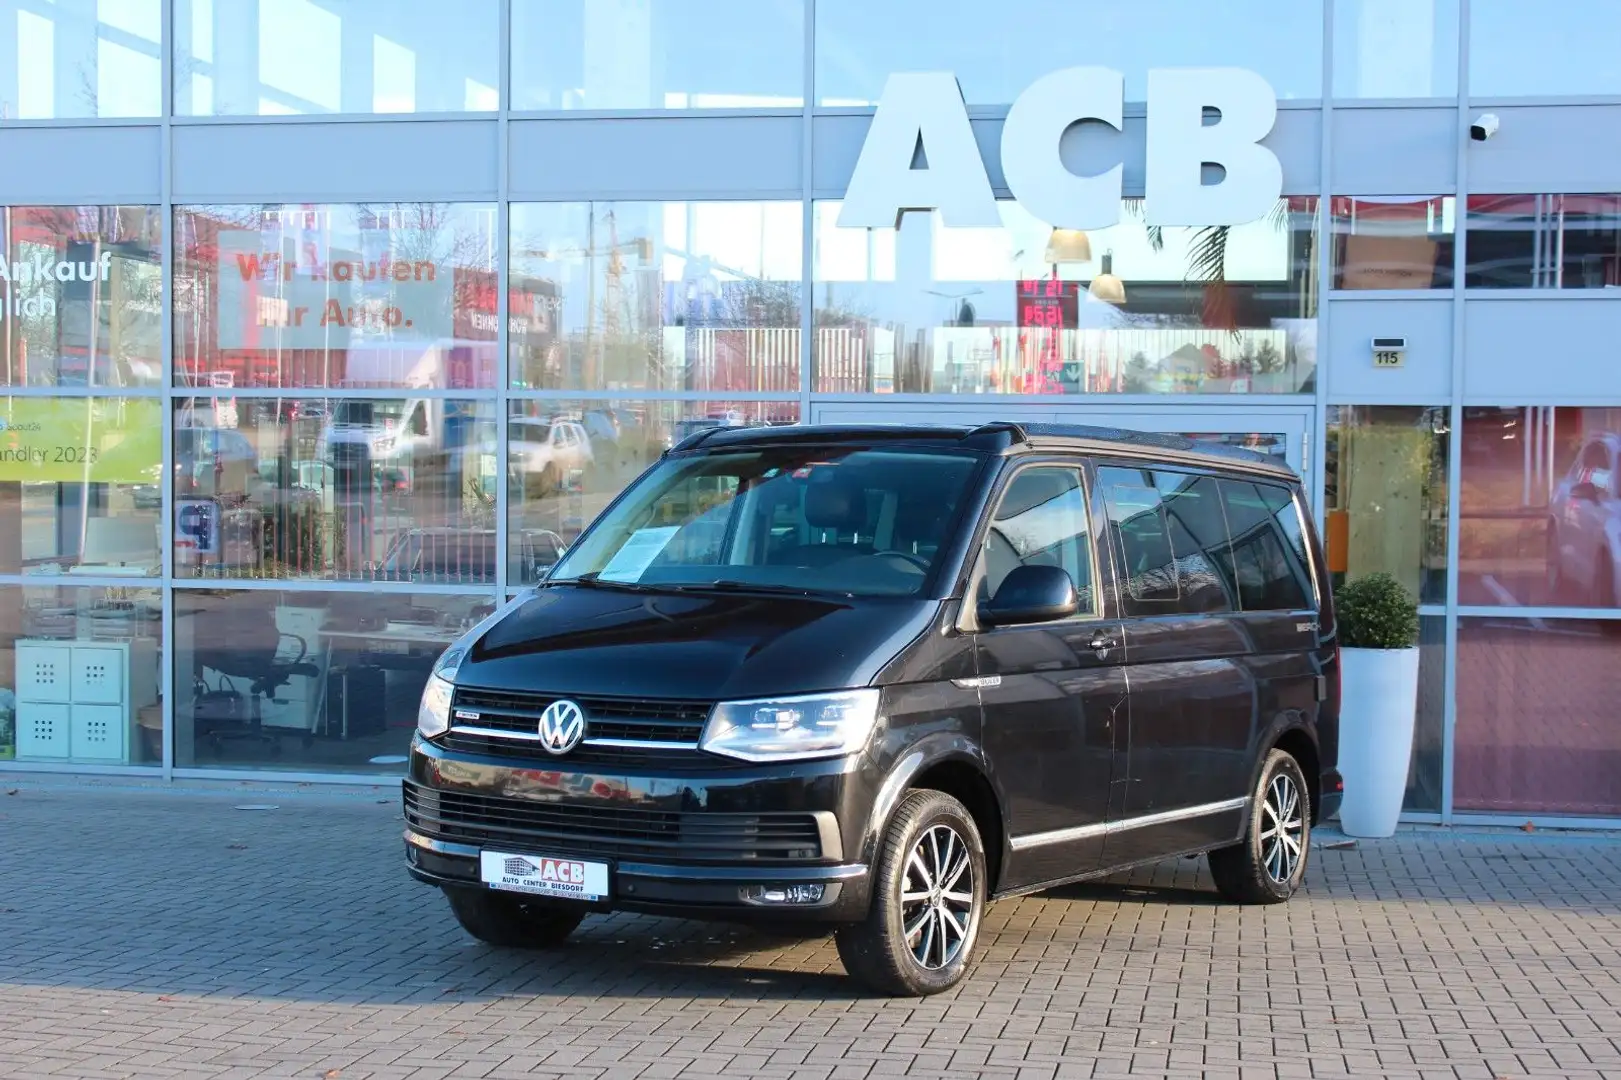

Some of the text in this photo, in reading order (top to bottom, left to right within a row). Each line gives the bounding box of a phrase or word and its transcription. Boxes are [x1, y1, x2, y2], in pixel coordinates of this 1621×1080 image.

[836, 66, 1283, 230] ACB
[235, 251, 436, 282] Wir kaufen
[320, 298, 413, 328] Auto.
[1375, 352, 1398, 364] 115
[54, 446, 99, 463] 2023
[502, 876, 519, 885] AUTO
[523, 879, 547, 888] CENTER
[551, 882, 584, 892] BIESDORF
[542, 859, 584, 884] ACB
